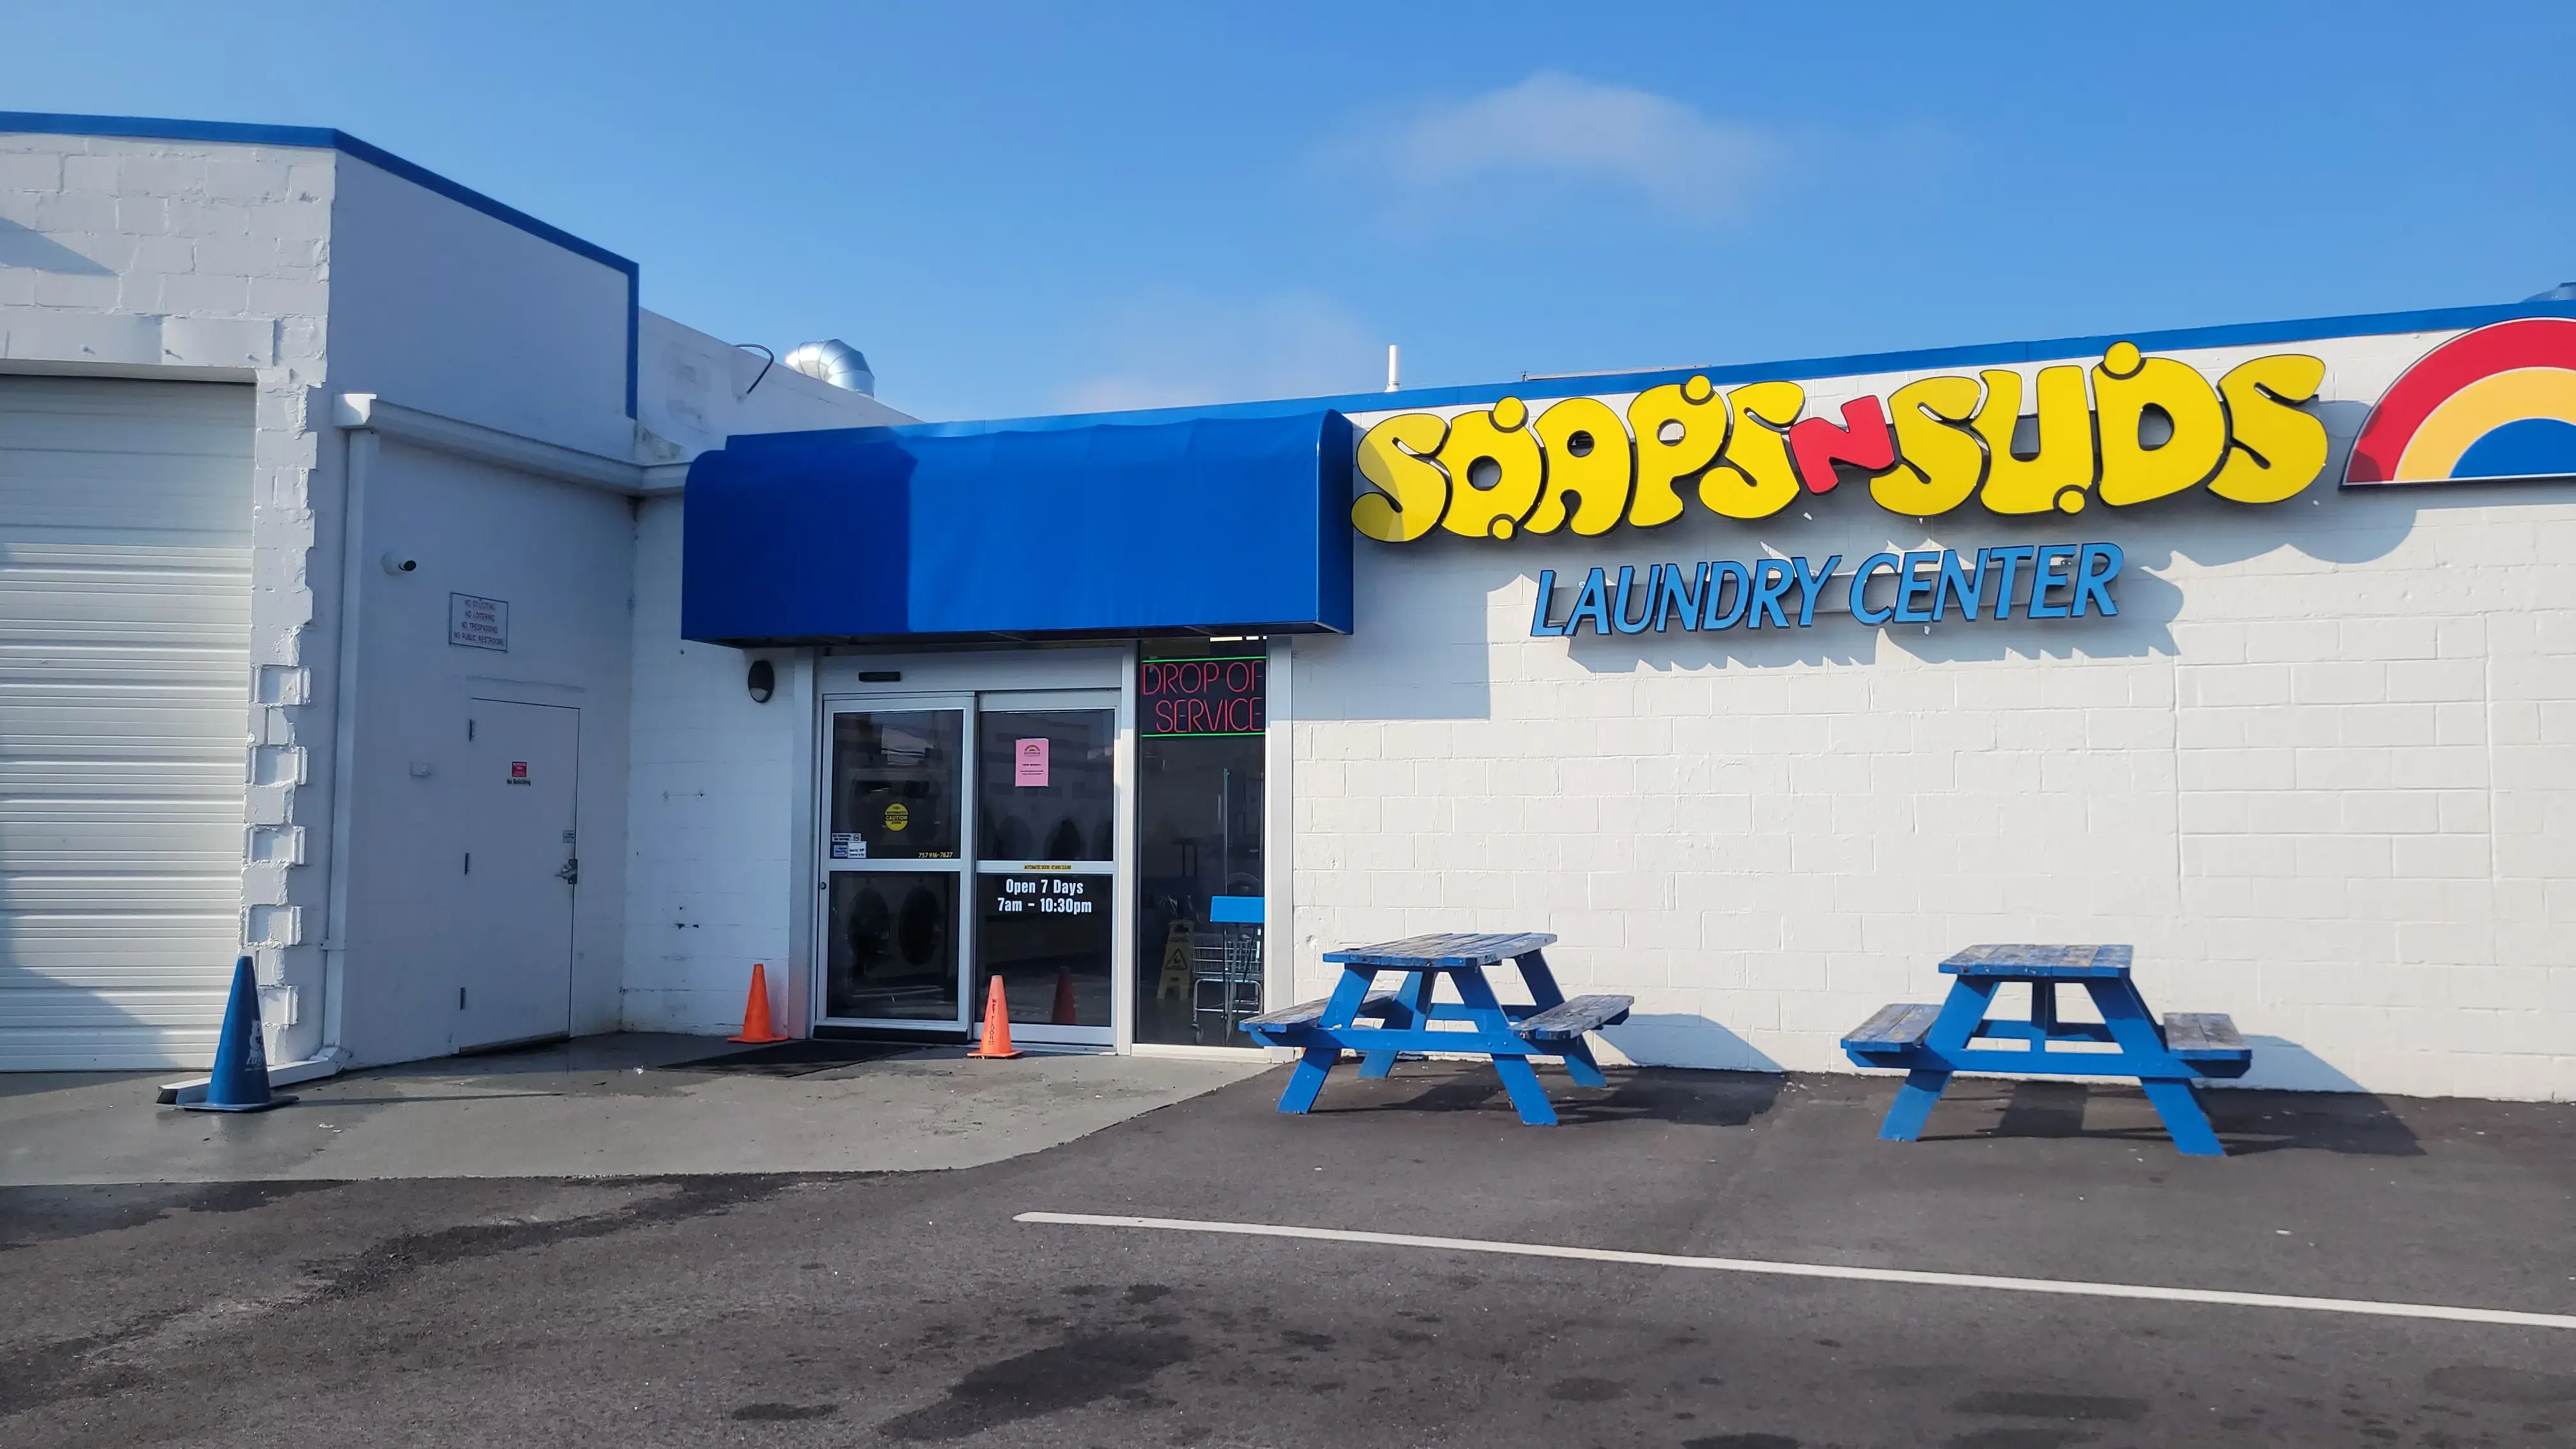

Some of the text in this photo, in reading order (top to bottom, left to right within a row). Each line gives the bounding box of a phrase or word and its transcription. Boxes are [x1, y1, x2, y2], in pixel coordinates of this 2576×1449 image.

[1351, 341, 2328, 543] SOAPS N SUDS
[1530, 542, 2124, 638] LAUNDRY CENTER
[1141, 662, 1220, 696] DROP
[1155, 696, 1264, 733] SERVICE
[1006, 878, 1084, 896] Open 7 Days
[997, 897, 1022, 912] 7am
[1040, 898, 1092, 915] 10:30pm
